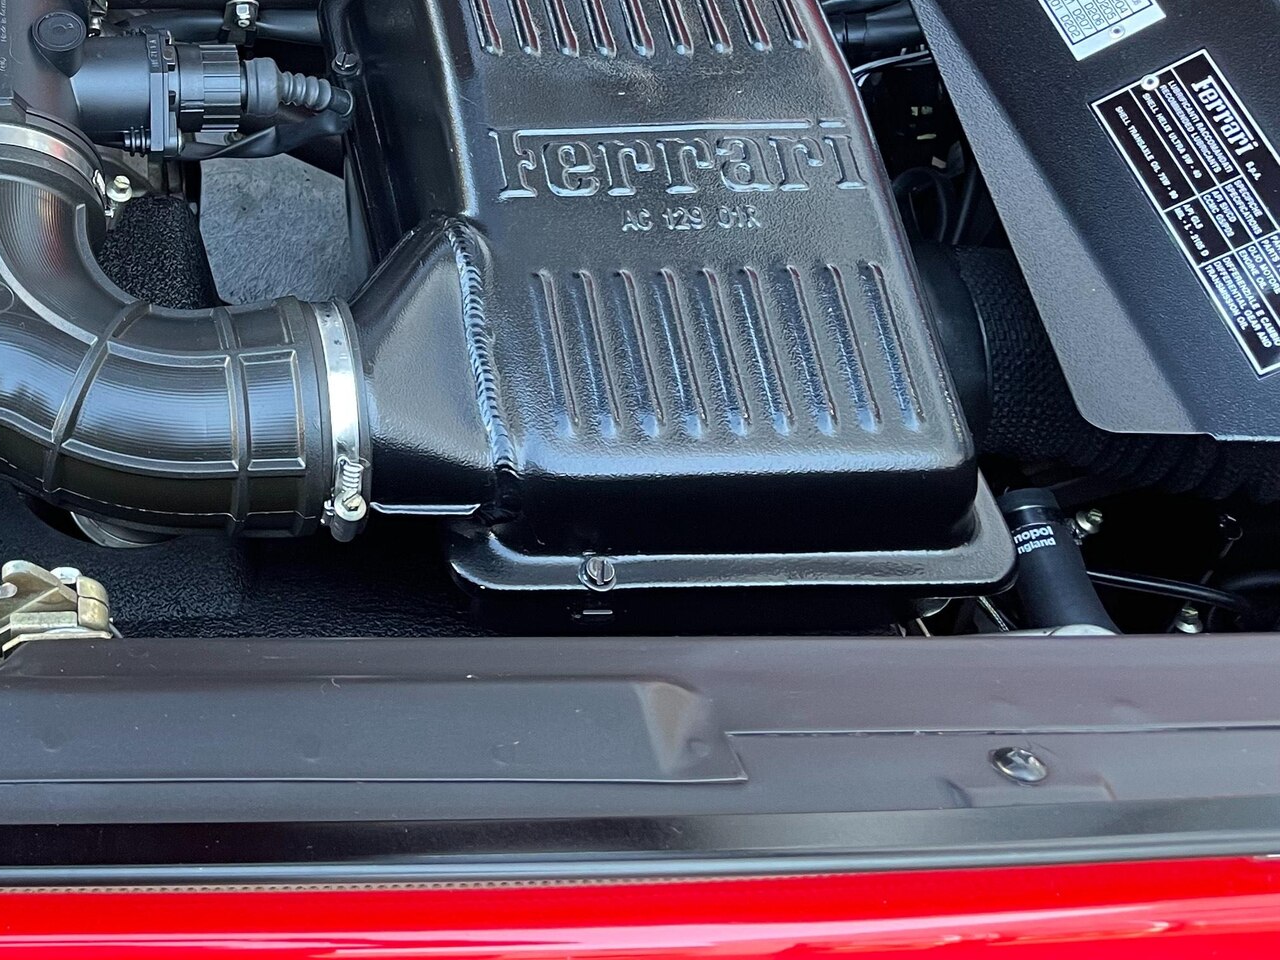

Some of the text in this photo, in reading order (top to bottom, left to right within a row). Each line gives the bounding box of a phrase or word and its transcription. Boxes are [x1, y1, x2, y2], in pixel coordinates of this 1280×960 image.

[1115, 105, 1131, 126] SHELL
[1142, 92, 1159, 114] SHELL
[1168, 132, 1186, 154] ULTRA
[1191, 74, 1259, 157] Ferrari
[487, 118, 868, 199] Ferrari
[1182, 204, 1195, 216] API
[1211, 190, 1224, 203] API
[1225, 184, 1263, 235] SPECIFICATIONS
[662, 207, 706, 231] 129
[1238, 249, 1267, 290] ENGINE OIL
[1247, 245, 1263, 263] OLIO
[1205, 265, 1249, 331] TRANSMISSION OIL
[1213, 261, 1272, 348] DIFFERENTIAL GEAR AND
[1013, 525, 1054, 544] nopol
[1017, 536, 1057, 555] ngland
